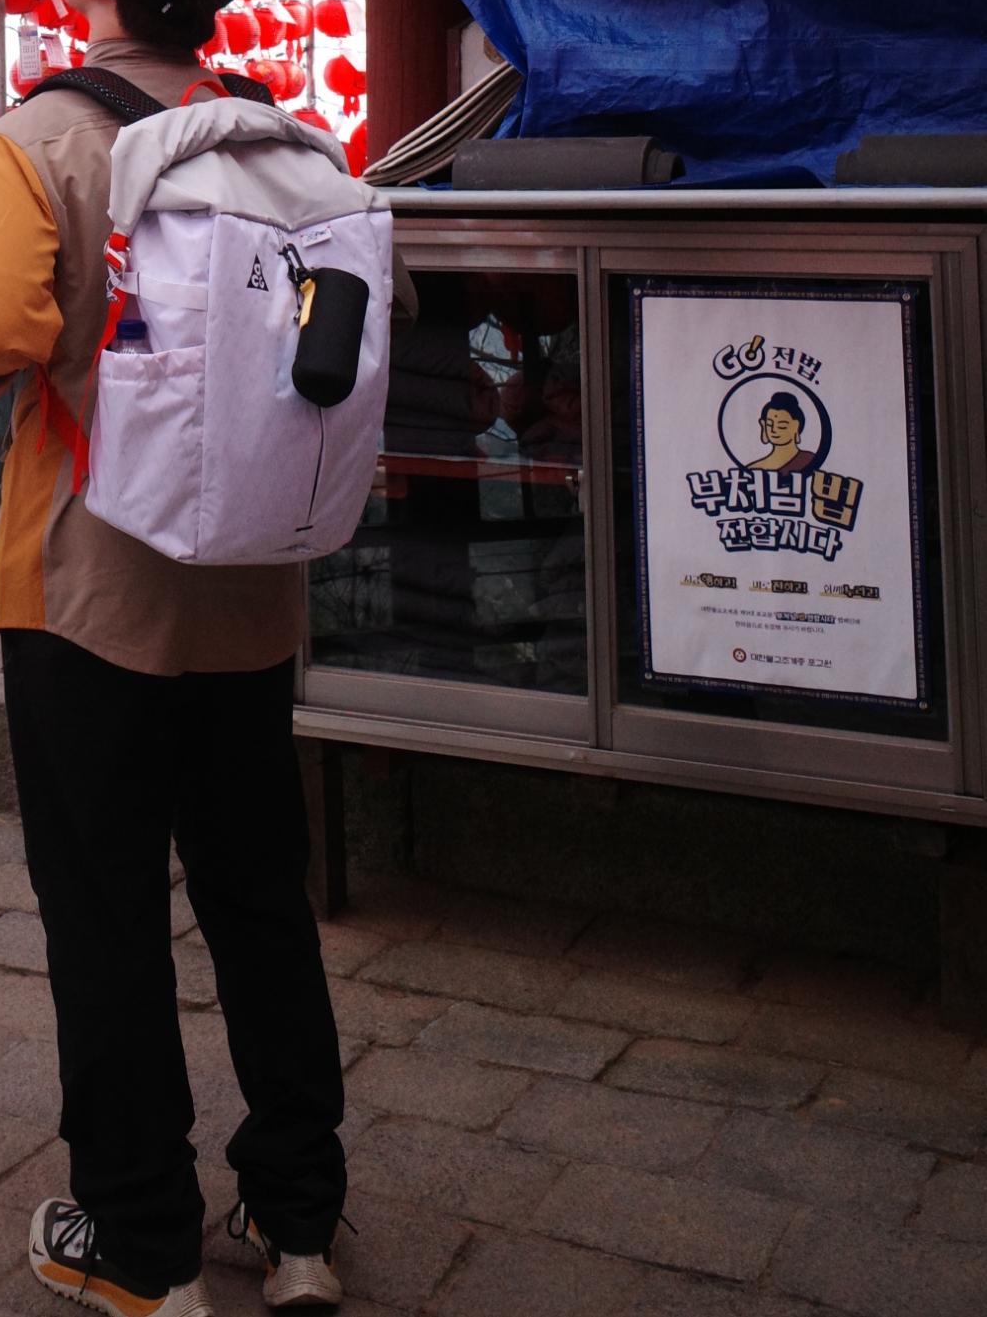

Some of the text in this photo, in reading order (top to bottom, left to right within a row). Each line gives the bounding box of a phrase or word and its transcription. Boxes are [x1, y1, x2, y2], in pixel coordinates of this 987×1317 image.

[685, 468, 865, 532] 부처님 법
[716, 518, 843, 562] 전합시다
[750, 653, 833, 669] 대한불교조계종 포교원
